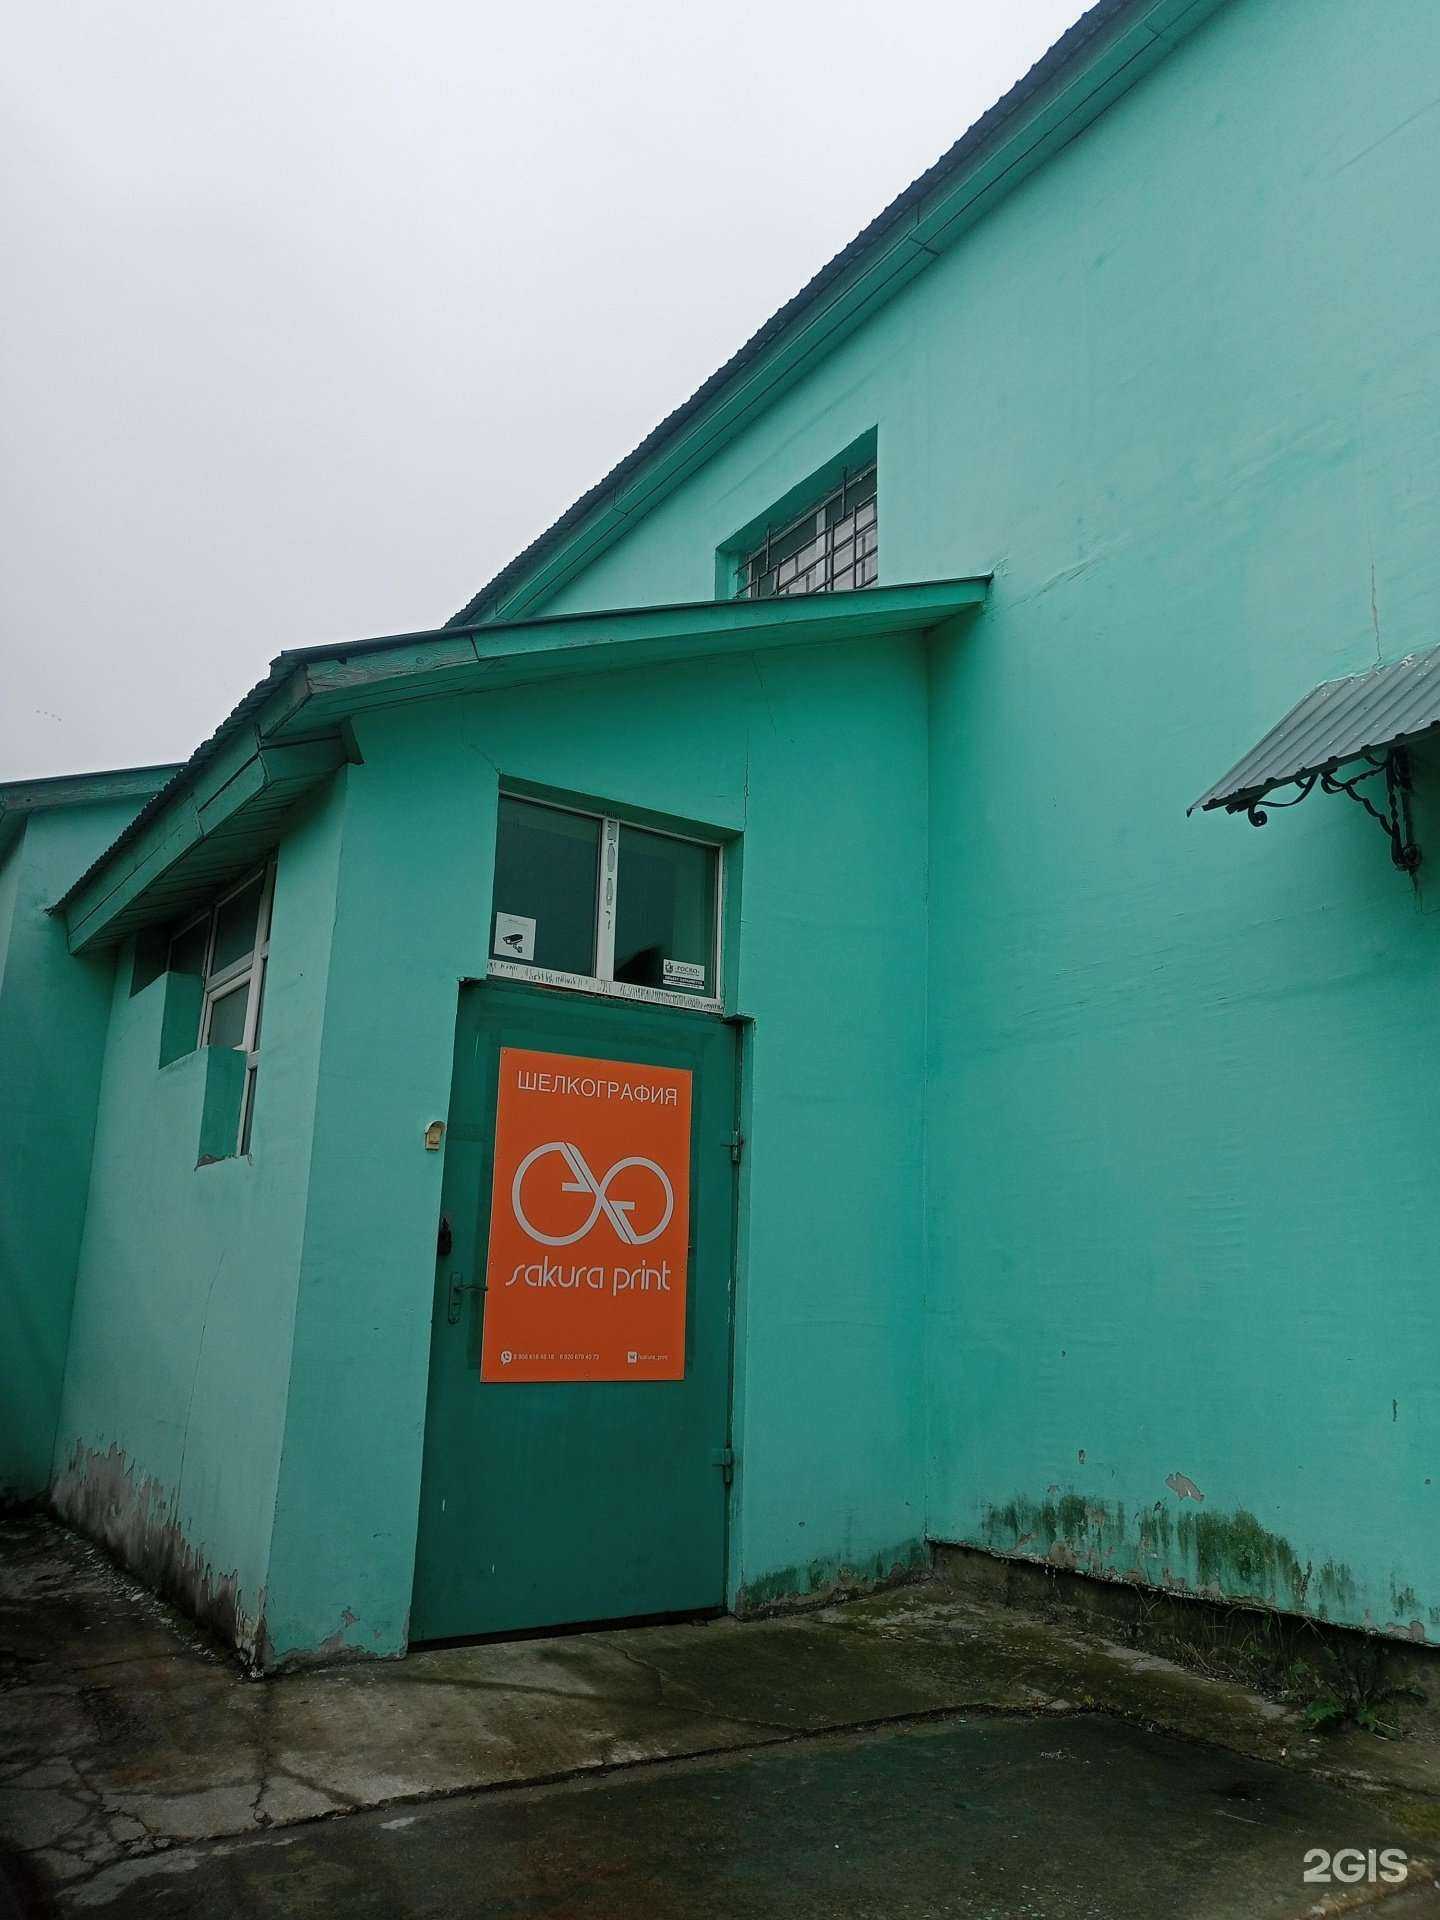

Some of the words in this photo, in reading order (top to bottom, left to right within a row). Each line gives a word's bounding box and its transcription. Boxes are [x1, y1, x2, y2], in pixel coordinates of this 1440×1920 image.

[517, 1070, 678, 1106] ШЕЛКОГРАФИЯ
[505, 1255, 604, 1289] sakura
[612, 1259, 672, 1297] print
